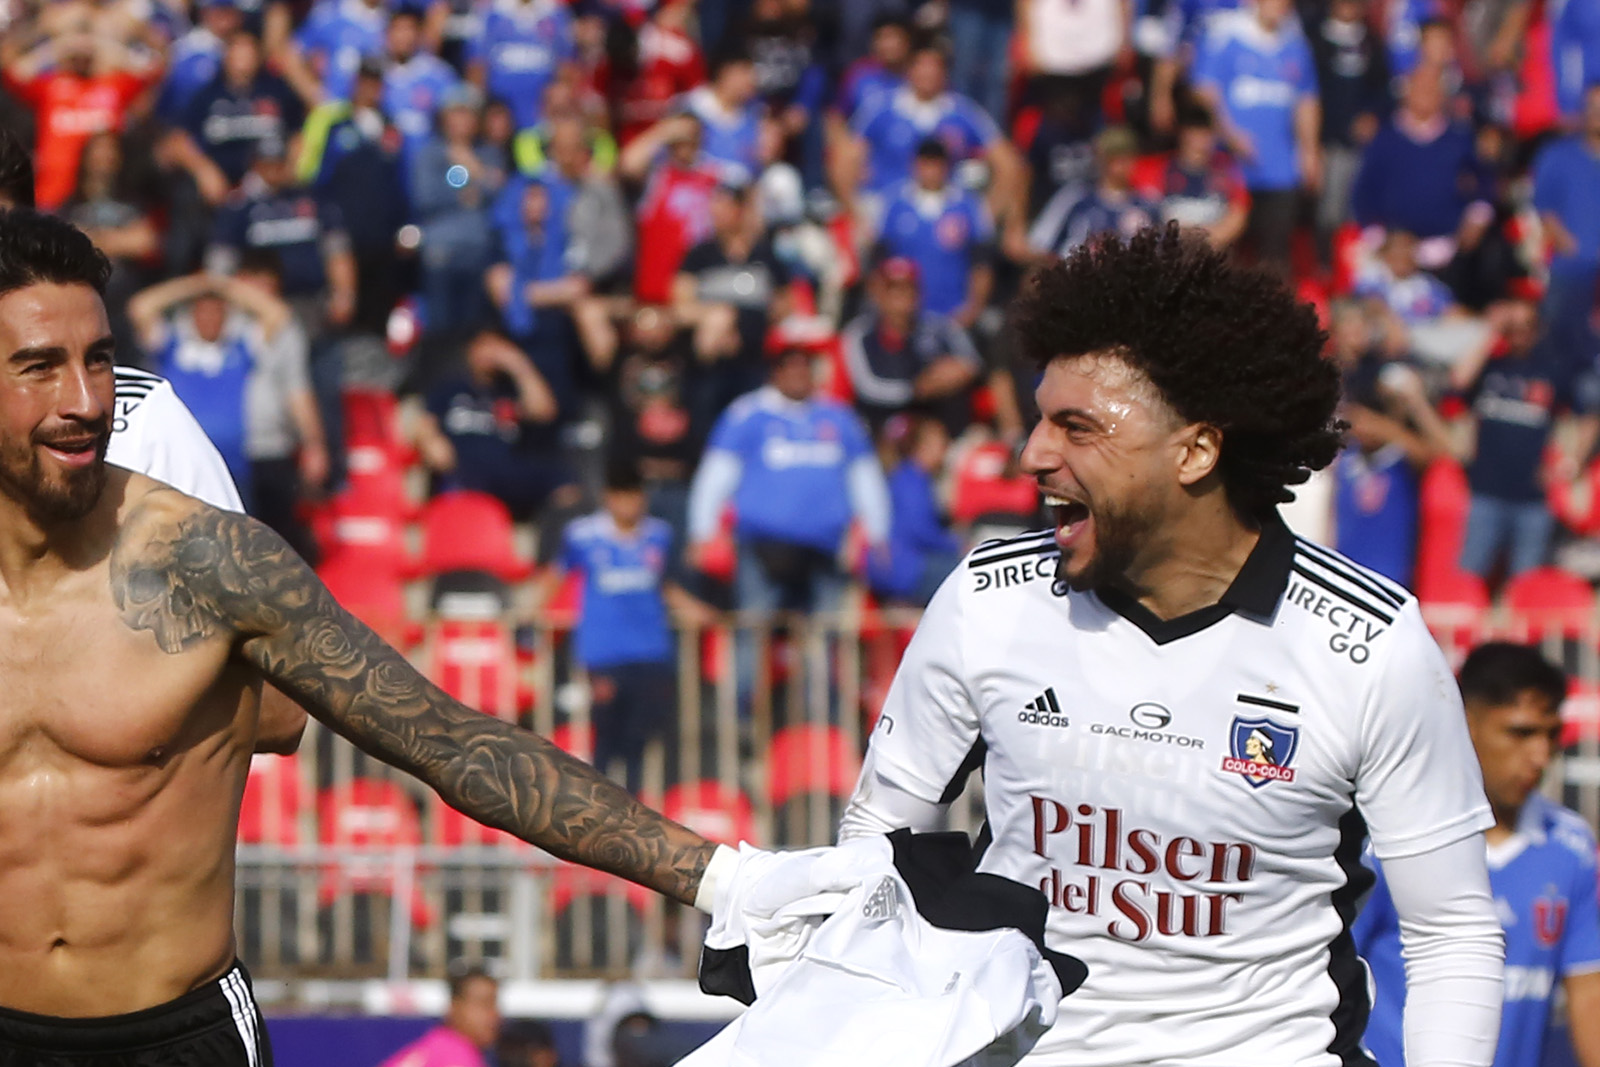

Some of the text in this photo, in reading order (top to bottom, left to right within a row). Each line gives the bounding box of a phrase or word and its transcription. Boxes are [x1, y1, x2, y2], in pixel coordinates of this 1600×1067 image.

[1287, 581, 1385, 643] IRECTV
[1329, 632, 1370, 665] GO
[1018, 710, 1069, 728] adidas
[1224, 757, 1293, 781] COLO-COLO
[1030, 794, 1257, 884] Pilsen
[1039, 867, 1245, 943] del Sur
